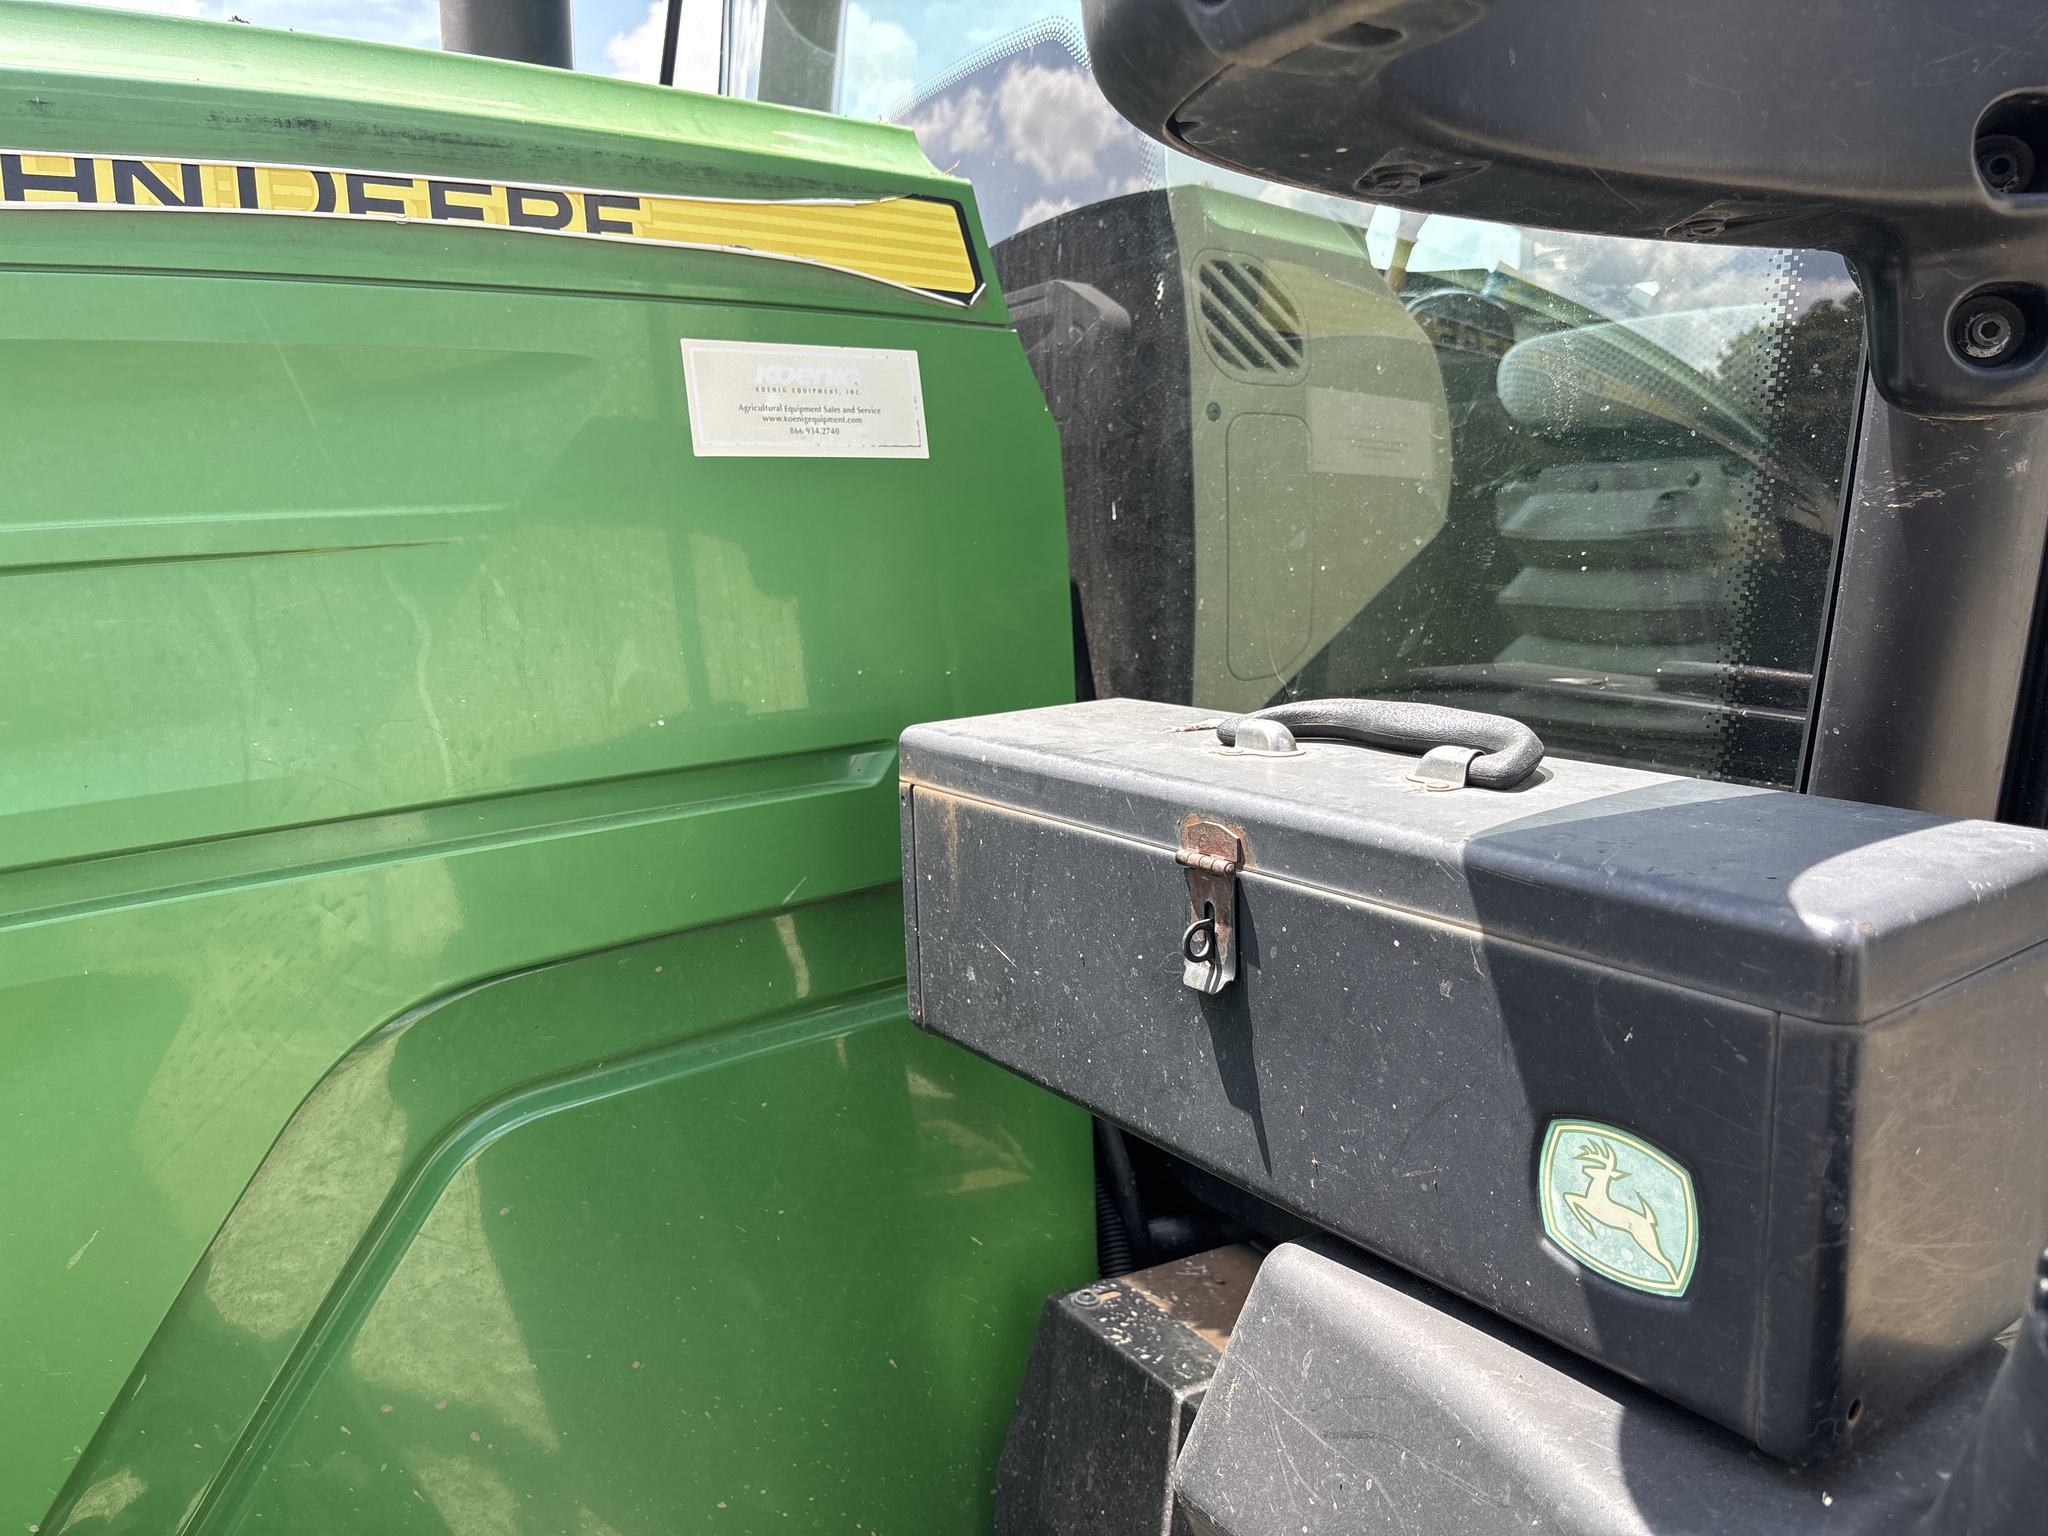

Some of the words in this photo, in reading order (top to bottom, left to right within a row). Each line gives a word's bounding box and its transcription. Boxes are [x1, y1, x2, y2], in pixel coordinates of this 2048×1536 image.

[792, 387, 841, 396] EQUIPMENT,
[738, 404, 783, 414] Agricultural
[784, 404, 822, 416] Equipment
[823, 406, 841, 414] Sales
[857, 406, 882, 415] Service
[762, 415, 863, 426] www.koenigequipment.com
[790, 427, 804, 435] 866
[805, 427, 840, 436] 934.2740
